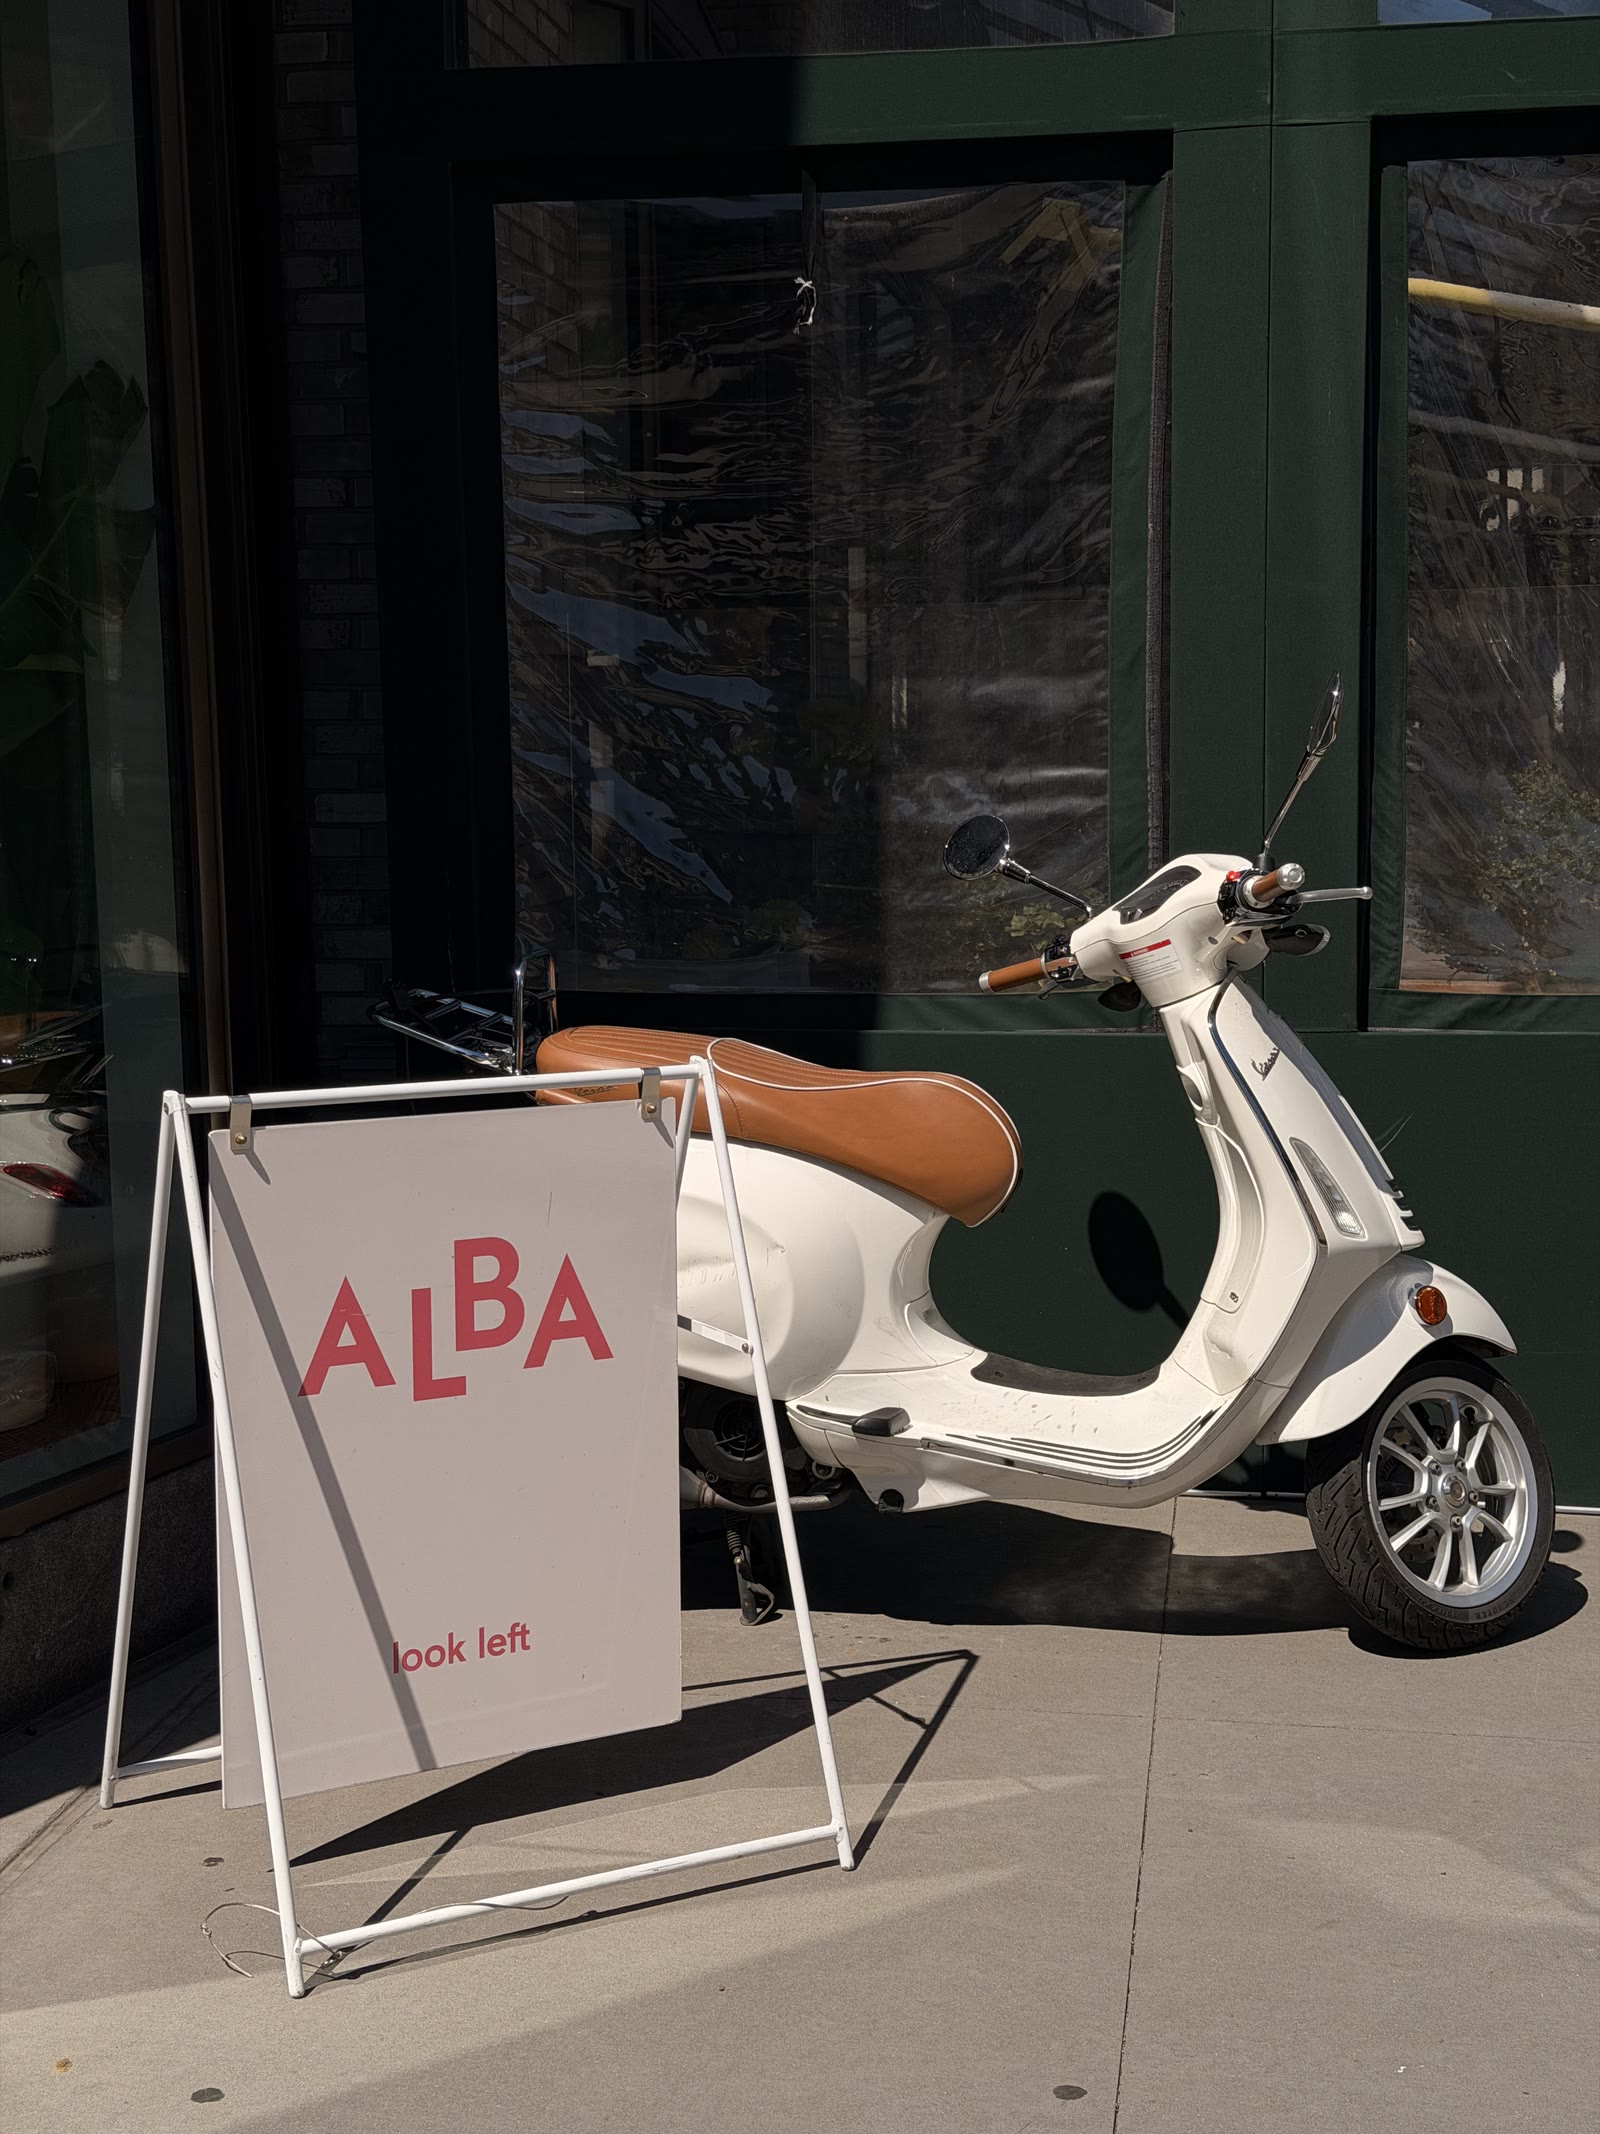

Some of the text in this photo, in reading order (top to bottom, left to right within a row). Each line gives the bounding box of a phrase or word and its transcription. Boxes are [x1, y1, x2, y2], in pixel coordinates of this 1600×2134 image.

[297, 1237, 614, 1402] ALBA
[393, 1622, 531, 1674] look left
